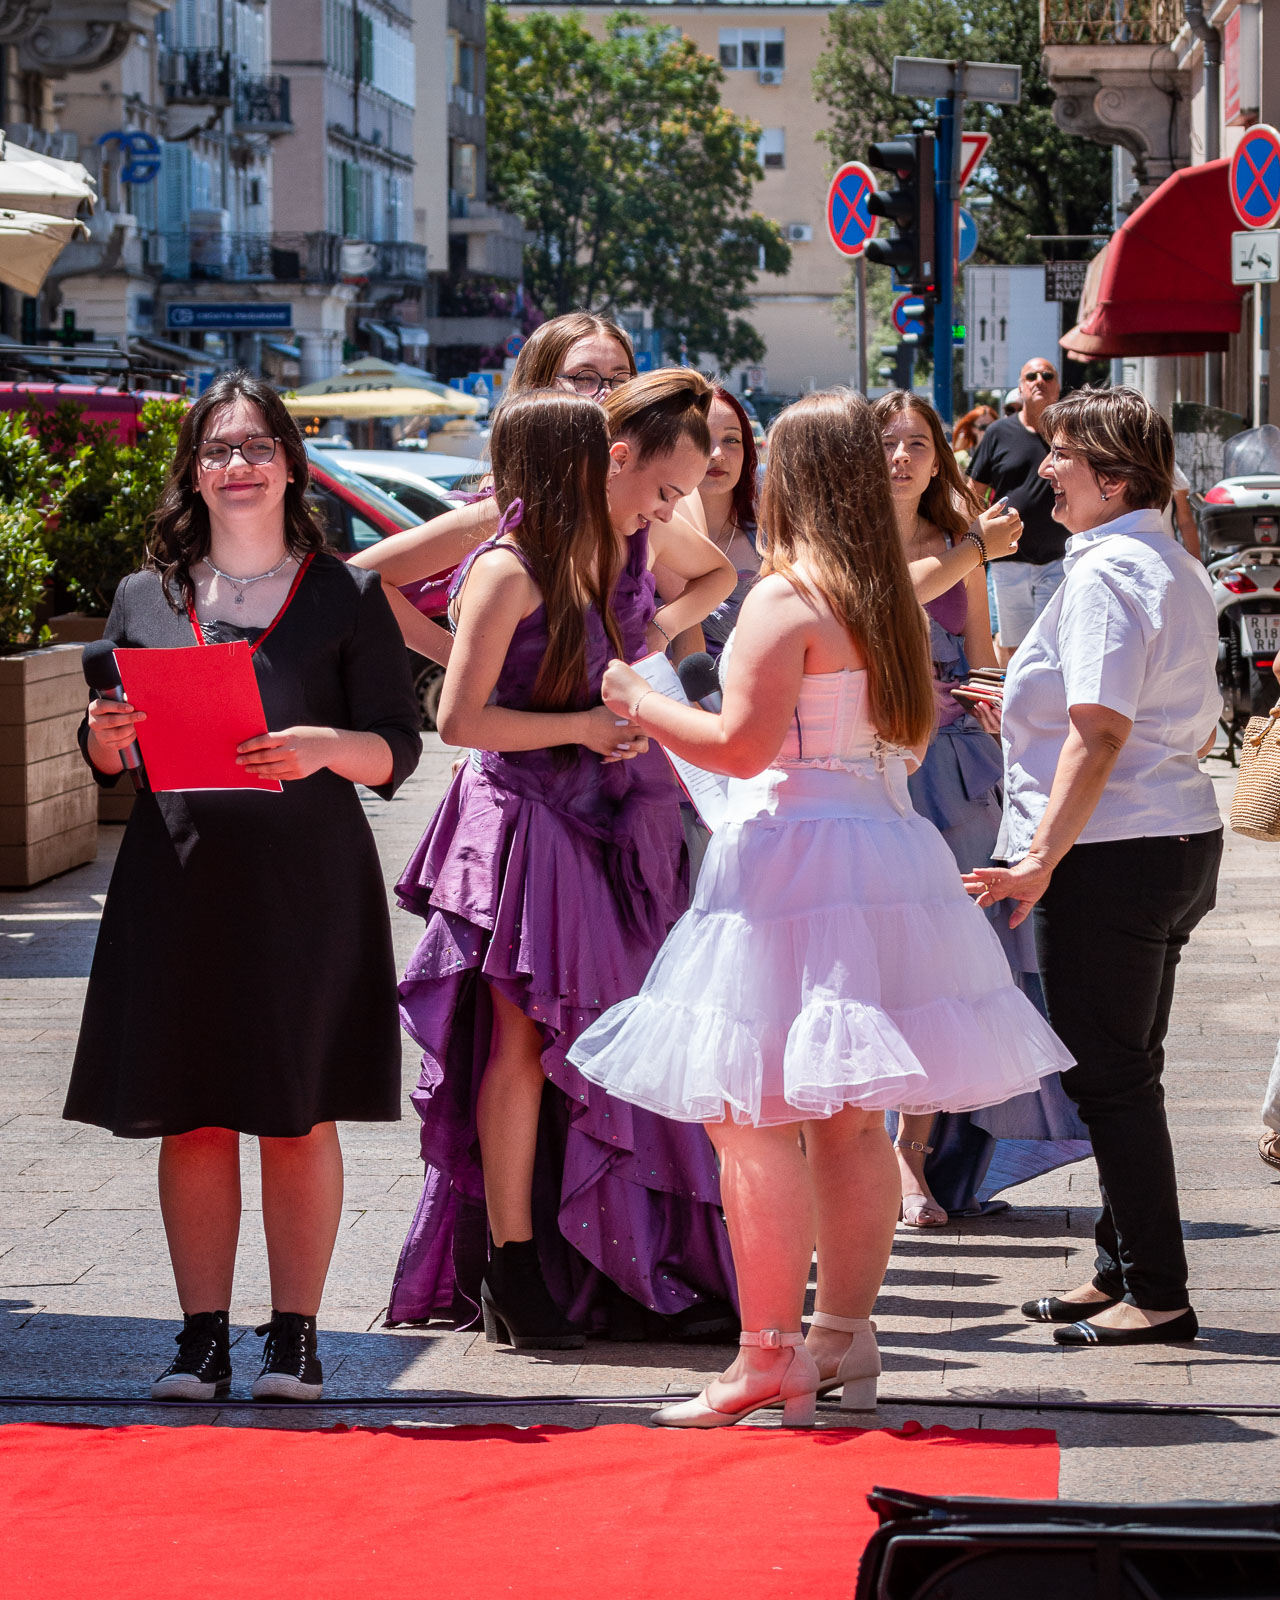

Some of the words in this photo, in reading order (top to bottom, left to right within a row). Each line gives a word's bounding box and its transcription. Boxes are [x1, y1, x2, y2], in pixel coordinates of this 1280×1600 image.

[1251, 617, 1267, 628] RI
[1254, 628, 1278, 639] 818
[1257, 639, 1276, 650] RH
